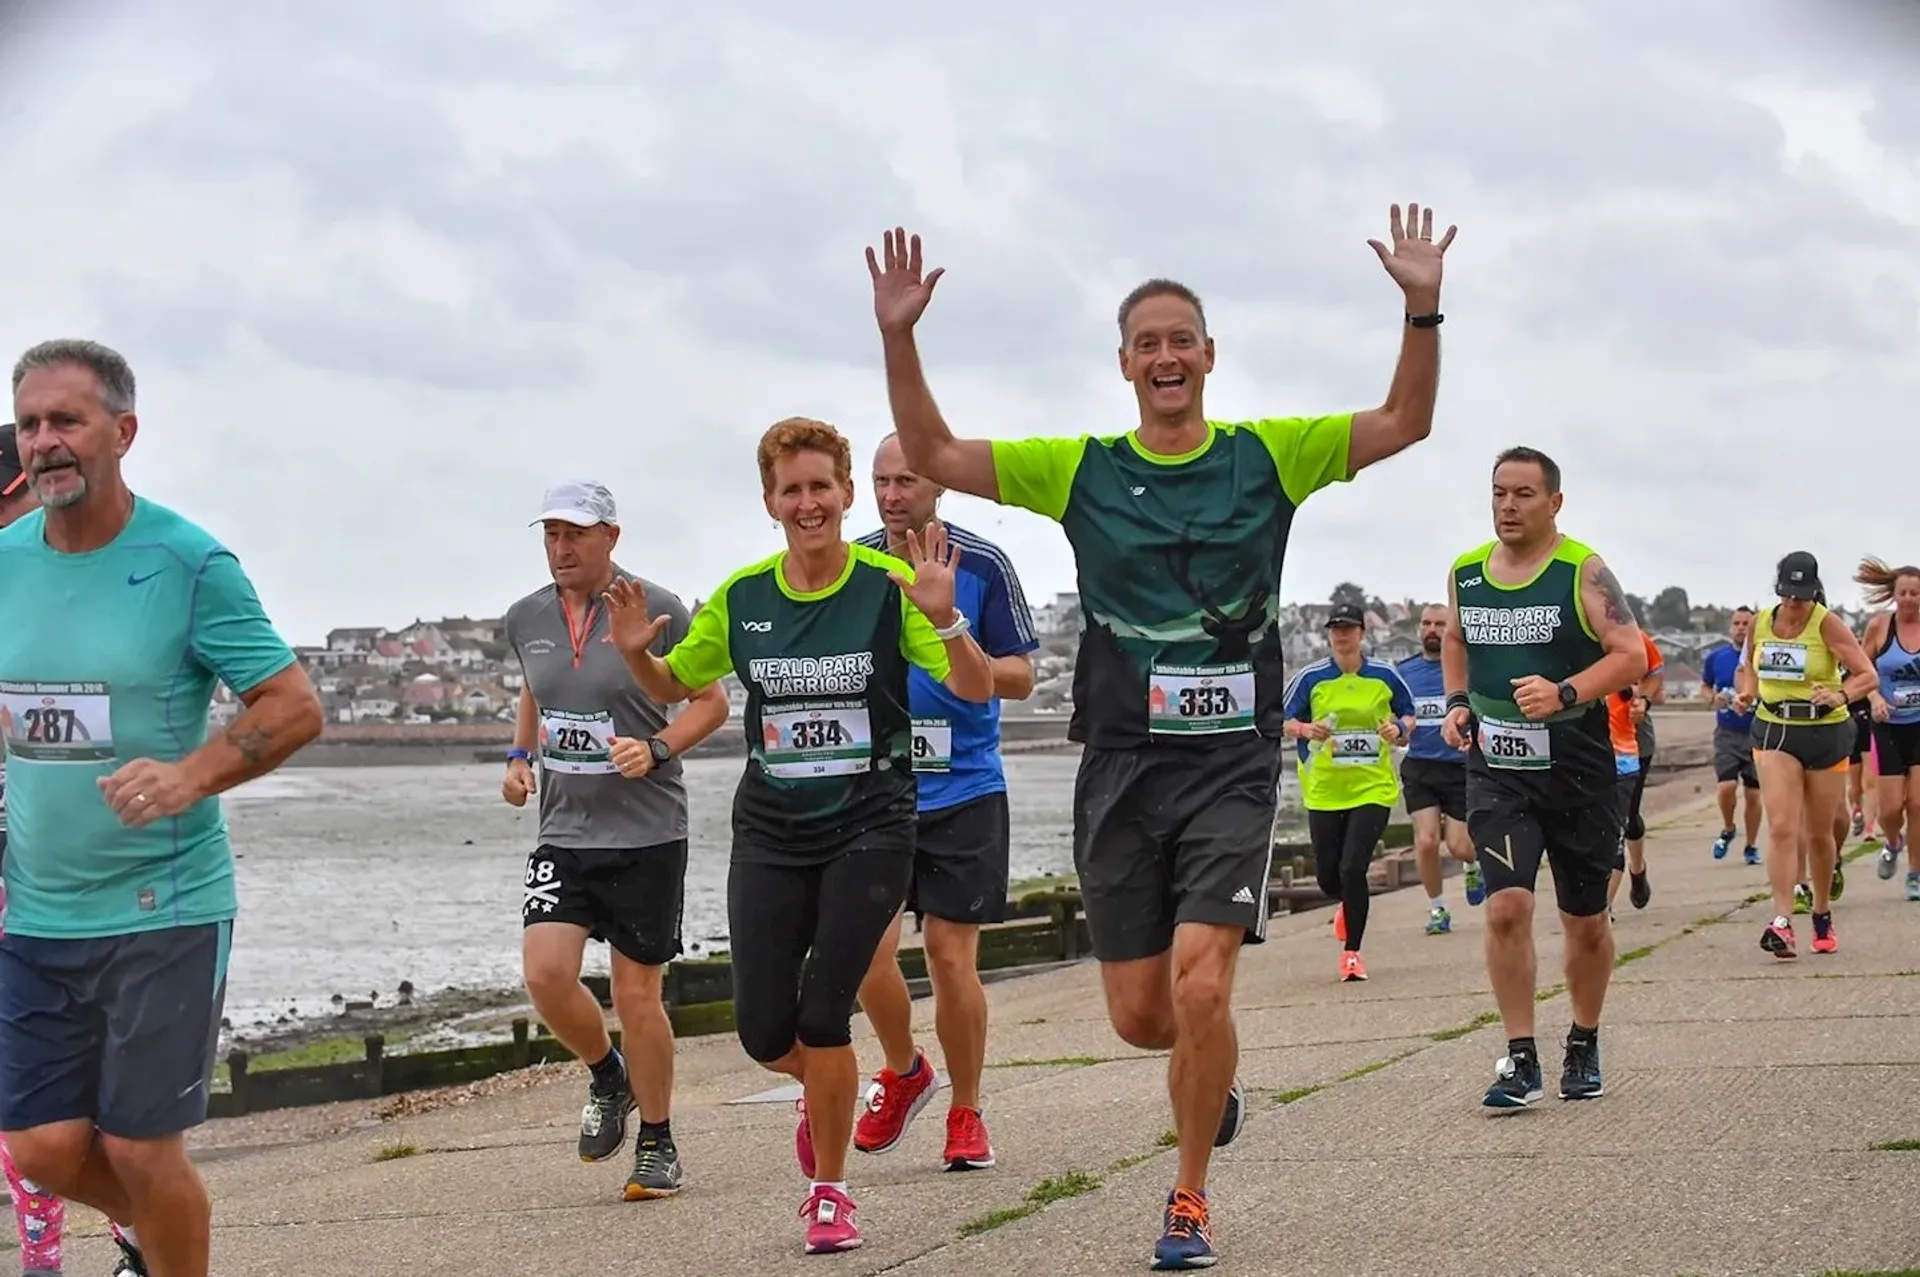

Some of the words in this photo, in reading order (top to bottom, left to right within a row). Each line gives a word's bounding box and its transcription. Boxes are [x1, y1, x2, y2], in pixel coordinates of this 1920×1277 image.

[1460, 607, 1511, 627] WEALD
[1513, 606, 1560, 626] PARK
[1467, 625, 1552, 643] WARRIORS
[750, 658, 818, 681] WEALD
[821, 653, 873, 677] PARK
[764, 674, 867, 697] WARRIORS
[1179, 687, 1230, 716] 333
[24, 708, 75, 743] 287
[791, 719, 842, 749] 334
[557, 728, 592, 751] 242
[1344, 739, 1367, 752] 342
[1492, 735, 1527, 757] 335
